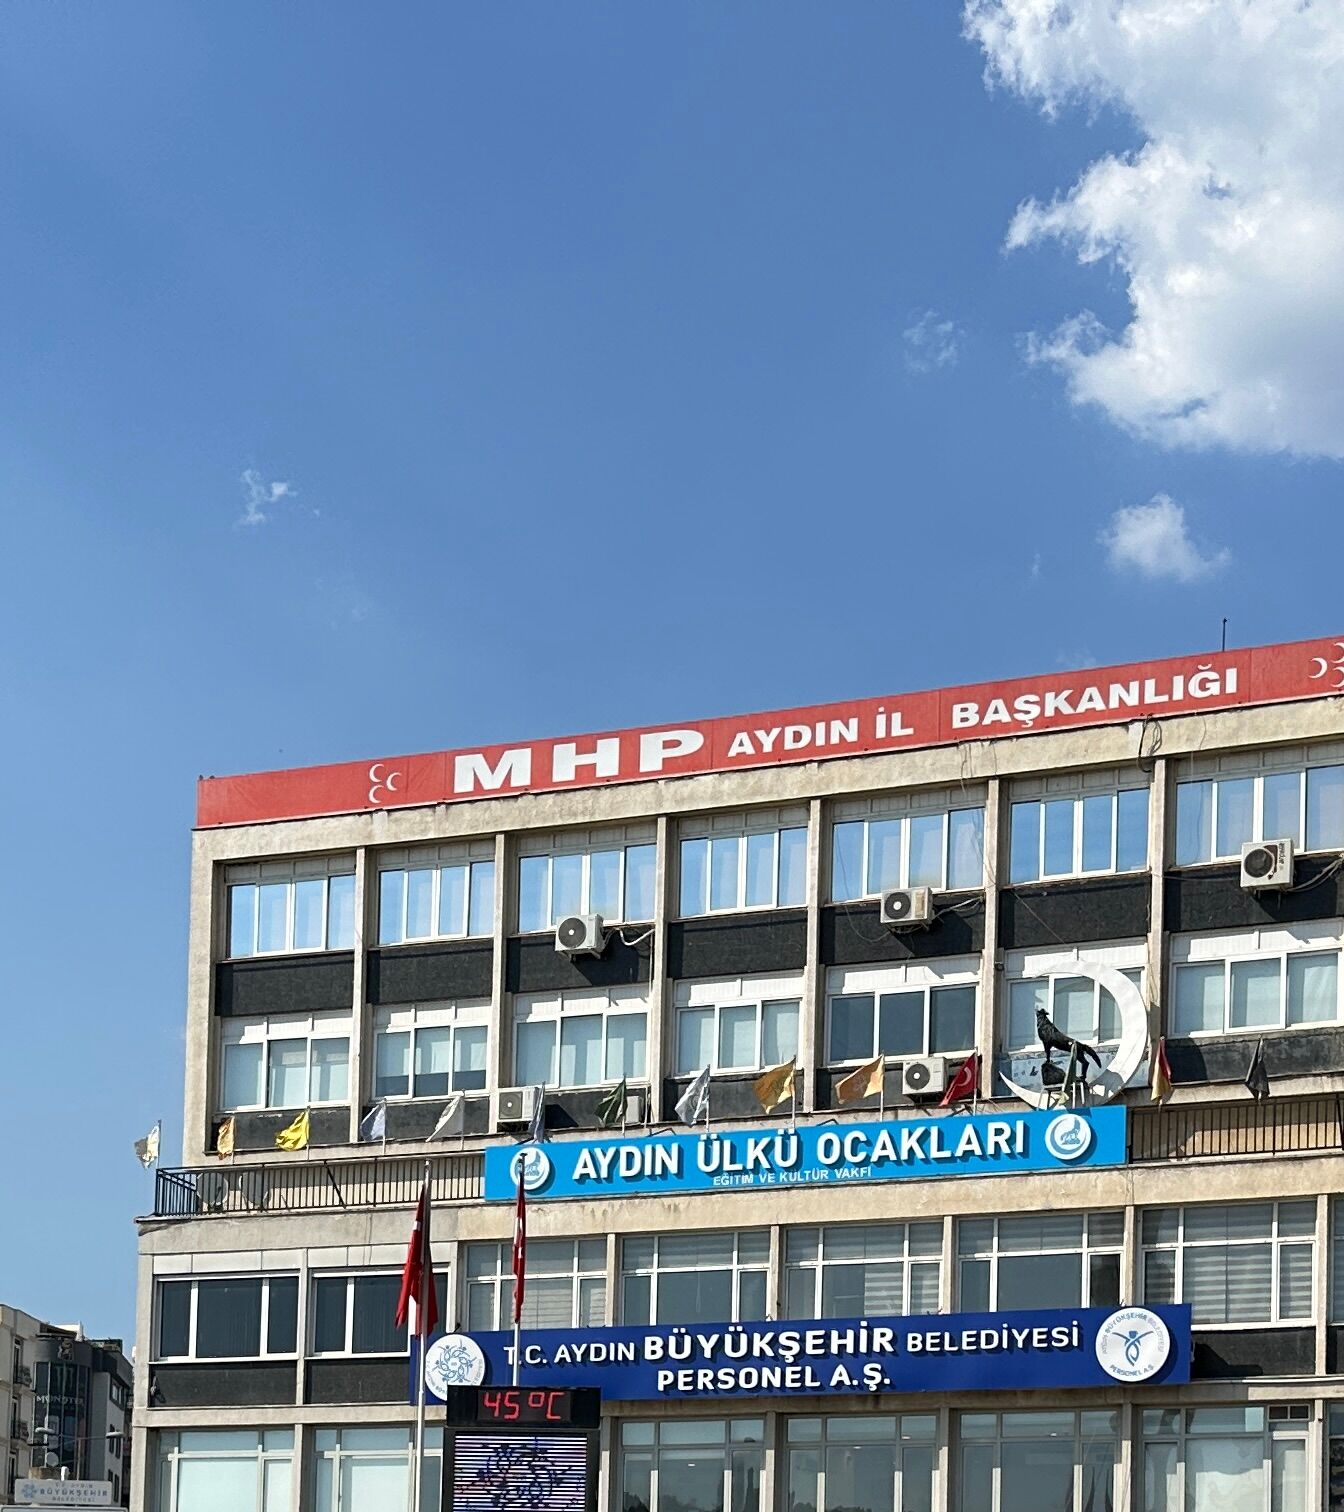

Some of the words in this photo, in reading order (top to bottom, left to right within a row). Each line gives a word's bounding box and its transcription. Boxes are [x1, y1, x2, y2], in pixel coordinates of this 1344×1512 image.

[454, 729, 705, 793] MHP
[728, 717, 858, 758] AYDIN
[875, 707, 914, 739] İL
[952, 663, 1238, 727] BAŞKANLIĞI
[573, 1142, 679, 1180] AYDIN
[697, 1128, 798, 1173] ÜLKÜ
[817, 1120, 1024, 1165] OCAKLARI
[713, 1171, 754, 1186] EĞİTİM
[759, 1172, 776, 1183] VE
[780, 1167, 829, 1182] KÜLTÜR
[834, 1166, 872, 1179] VAKFI
[554, 1342, 635, 1363] AYDIN
[644, 1321, 894, 1364] BÜYÜKŞEHİR
[907, 1320, 1078, 1352] BELEDİYESİ
[657, 1364, 820, 1391] PERSONEL
[484, 1392, 520, 1419] 45
